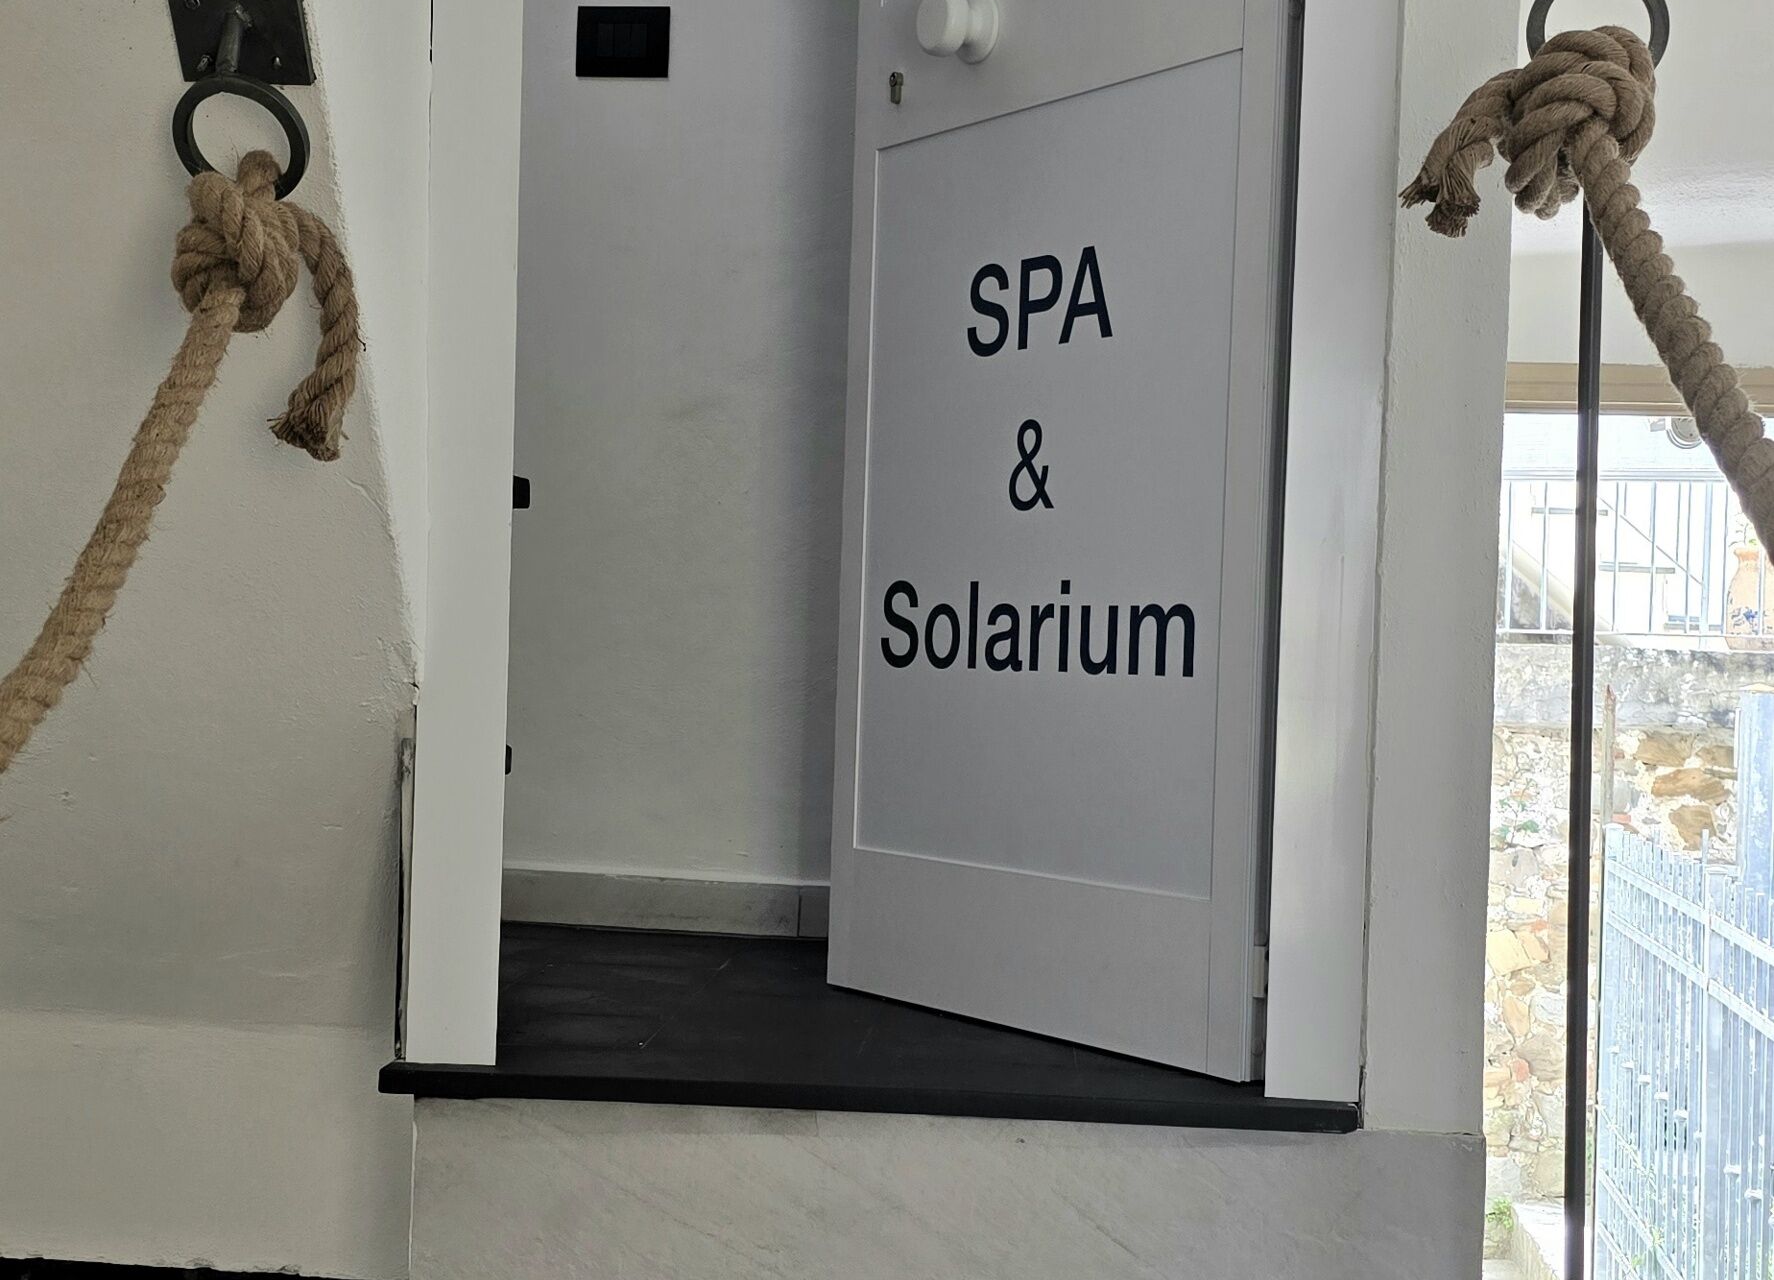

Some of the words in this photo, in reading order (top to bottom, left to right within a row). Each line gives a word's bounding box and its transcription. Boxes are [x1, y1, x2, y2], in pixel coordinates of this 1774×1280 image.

[967, 245, 1113, 357] SPA
[1008, 419, 1054, 511] &
[881, 579, 1196, 677] Solarium
